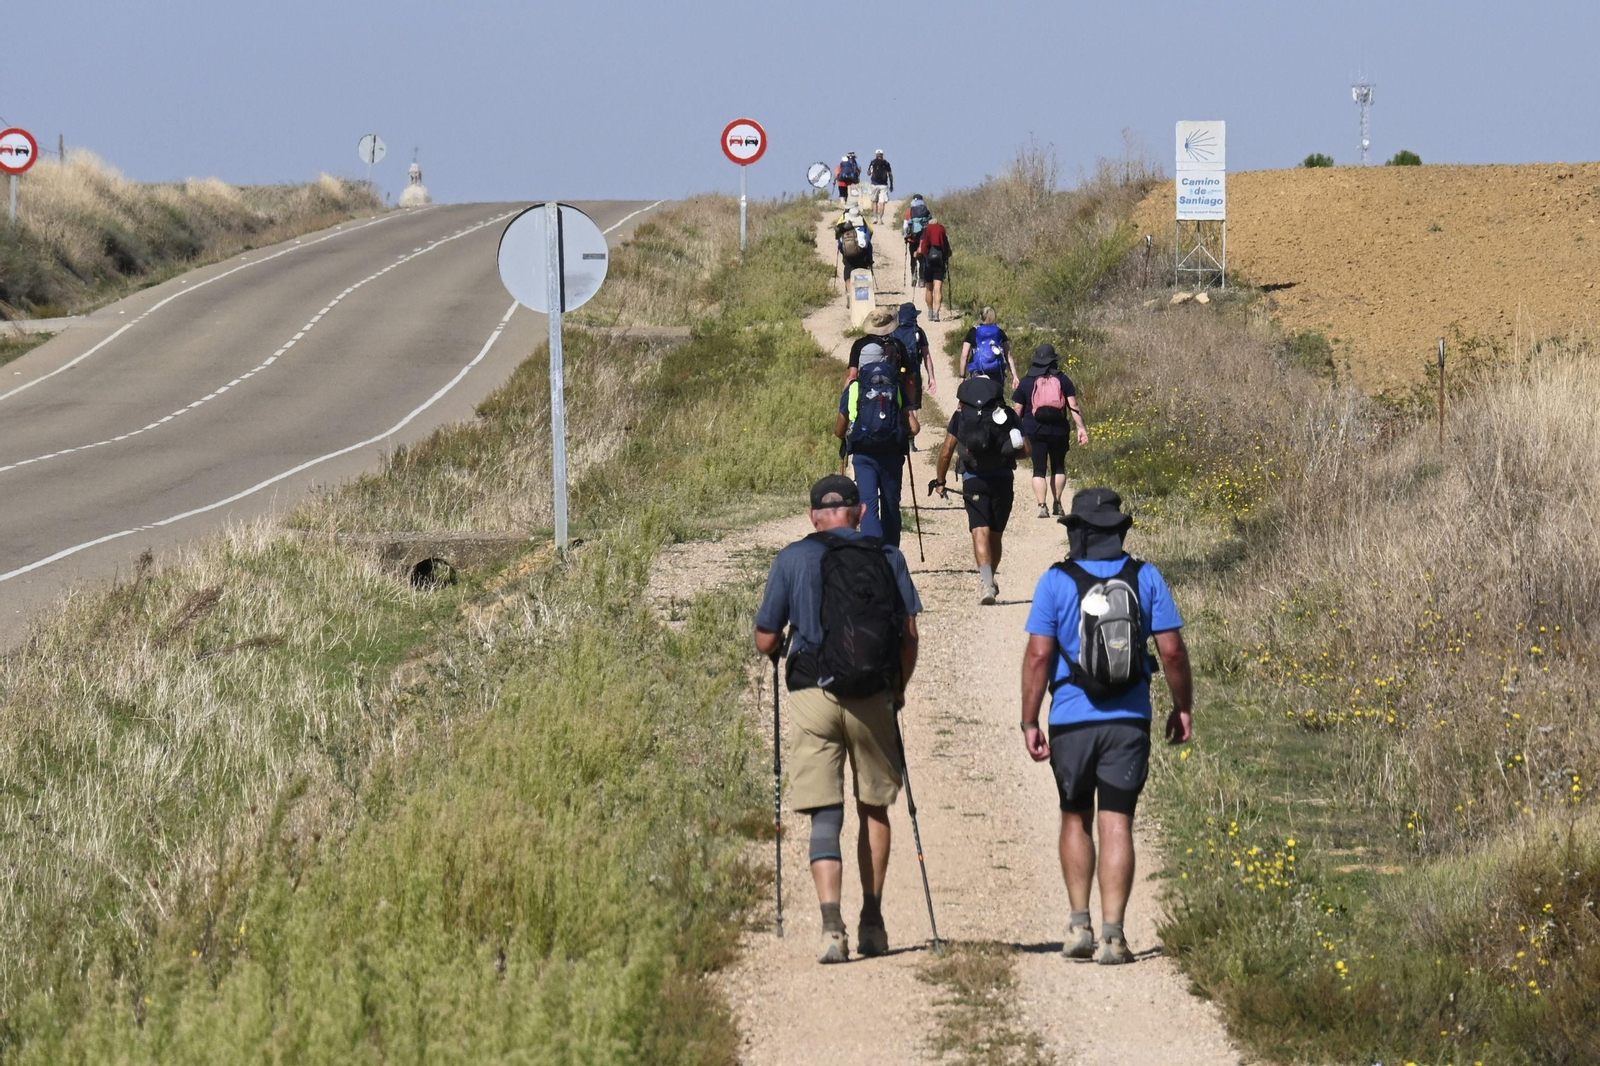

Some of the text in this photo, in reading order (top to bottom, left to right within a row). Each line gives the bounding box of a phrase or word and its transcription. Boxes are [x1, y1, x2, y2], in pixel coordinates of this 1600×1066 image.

[1182, 177, 1220, 186] Camino
[1194, 187, 1206, 195] de
[1179, 196, 1224, 206] Santiago
